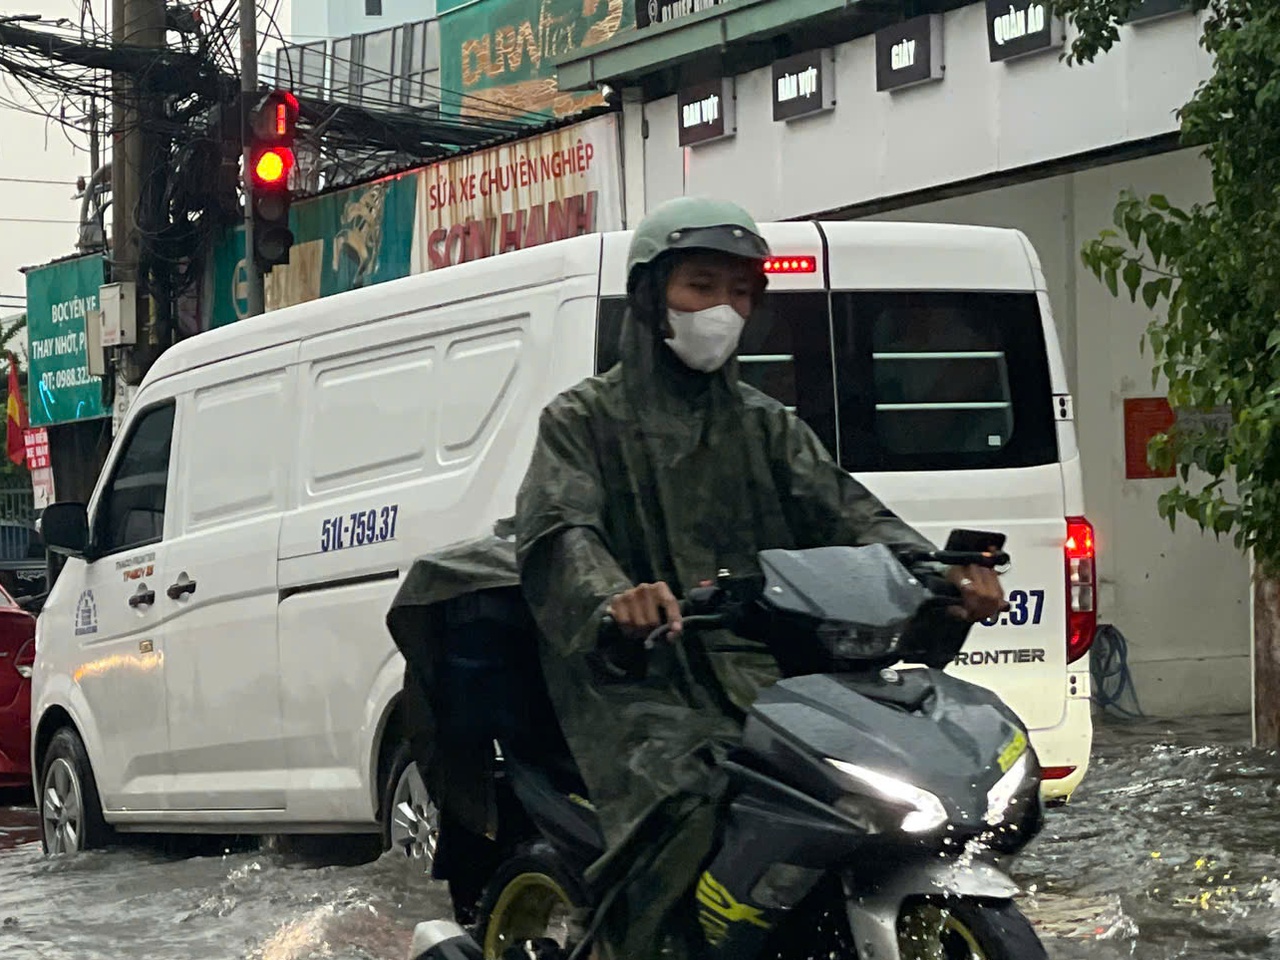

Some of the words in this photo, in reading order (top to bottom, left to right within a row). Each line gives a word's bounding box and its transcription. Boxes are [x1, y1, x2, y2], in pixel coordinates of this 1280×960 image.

[1027, 4, 1044, 33] ÁO
[798, 66, 817, 98] VỢT
[701, 94, 719, 125] VỢT
[429, 173, 458, 211] SỬA
[459, 173, 477, 204] XE
[479, 155, 538, 198] CHUYÊN
[540, 138, 595, 183] NGHIỆP
[52, 303, 69, 327] BỌC
[69, 296, 86, 321] YÊN
[32, 337, 54, 360] THAY
[321, 504, 399, 553] 51L-759.37
[953, 648, 1046, 667] RONTIER
